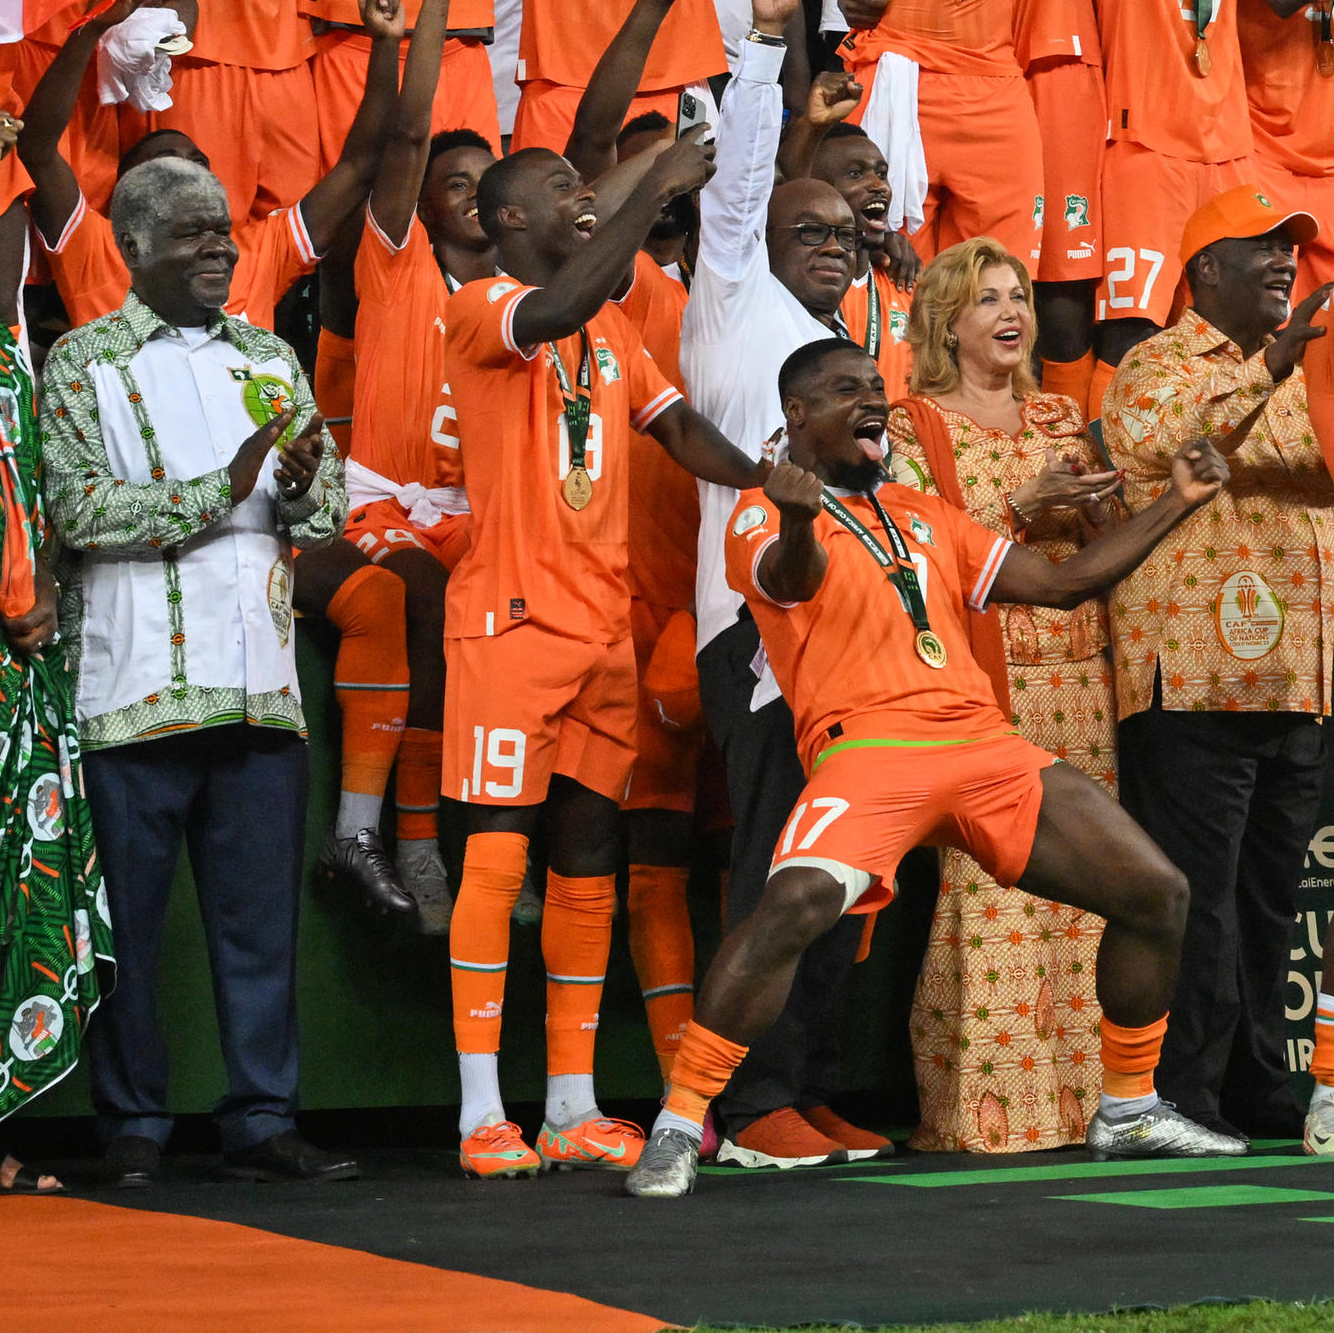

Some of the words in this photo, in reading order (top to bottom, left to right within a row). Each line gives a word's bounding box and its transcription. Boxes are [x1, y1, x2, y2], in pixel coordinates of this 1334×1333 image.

[1067, 248, 1092, 260] PUMA
[1107, 246, 1165, 309] 27
[826, 500, 837, 511] OF
[834, 506, 847, 520] CUP
[844, 515, 864, 536] AFRICA
[473, 724, 527, 799] 19
[781, 797, 851, 855] 17
